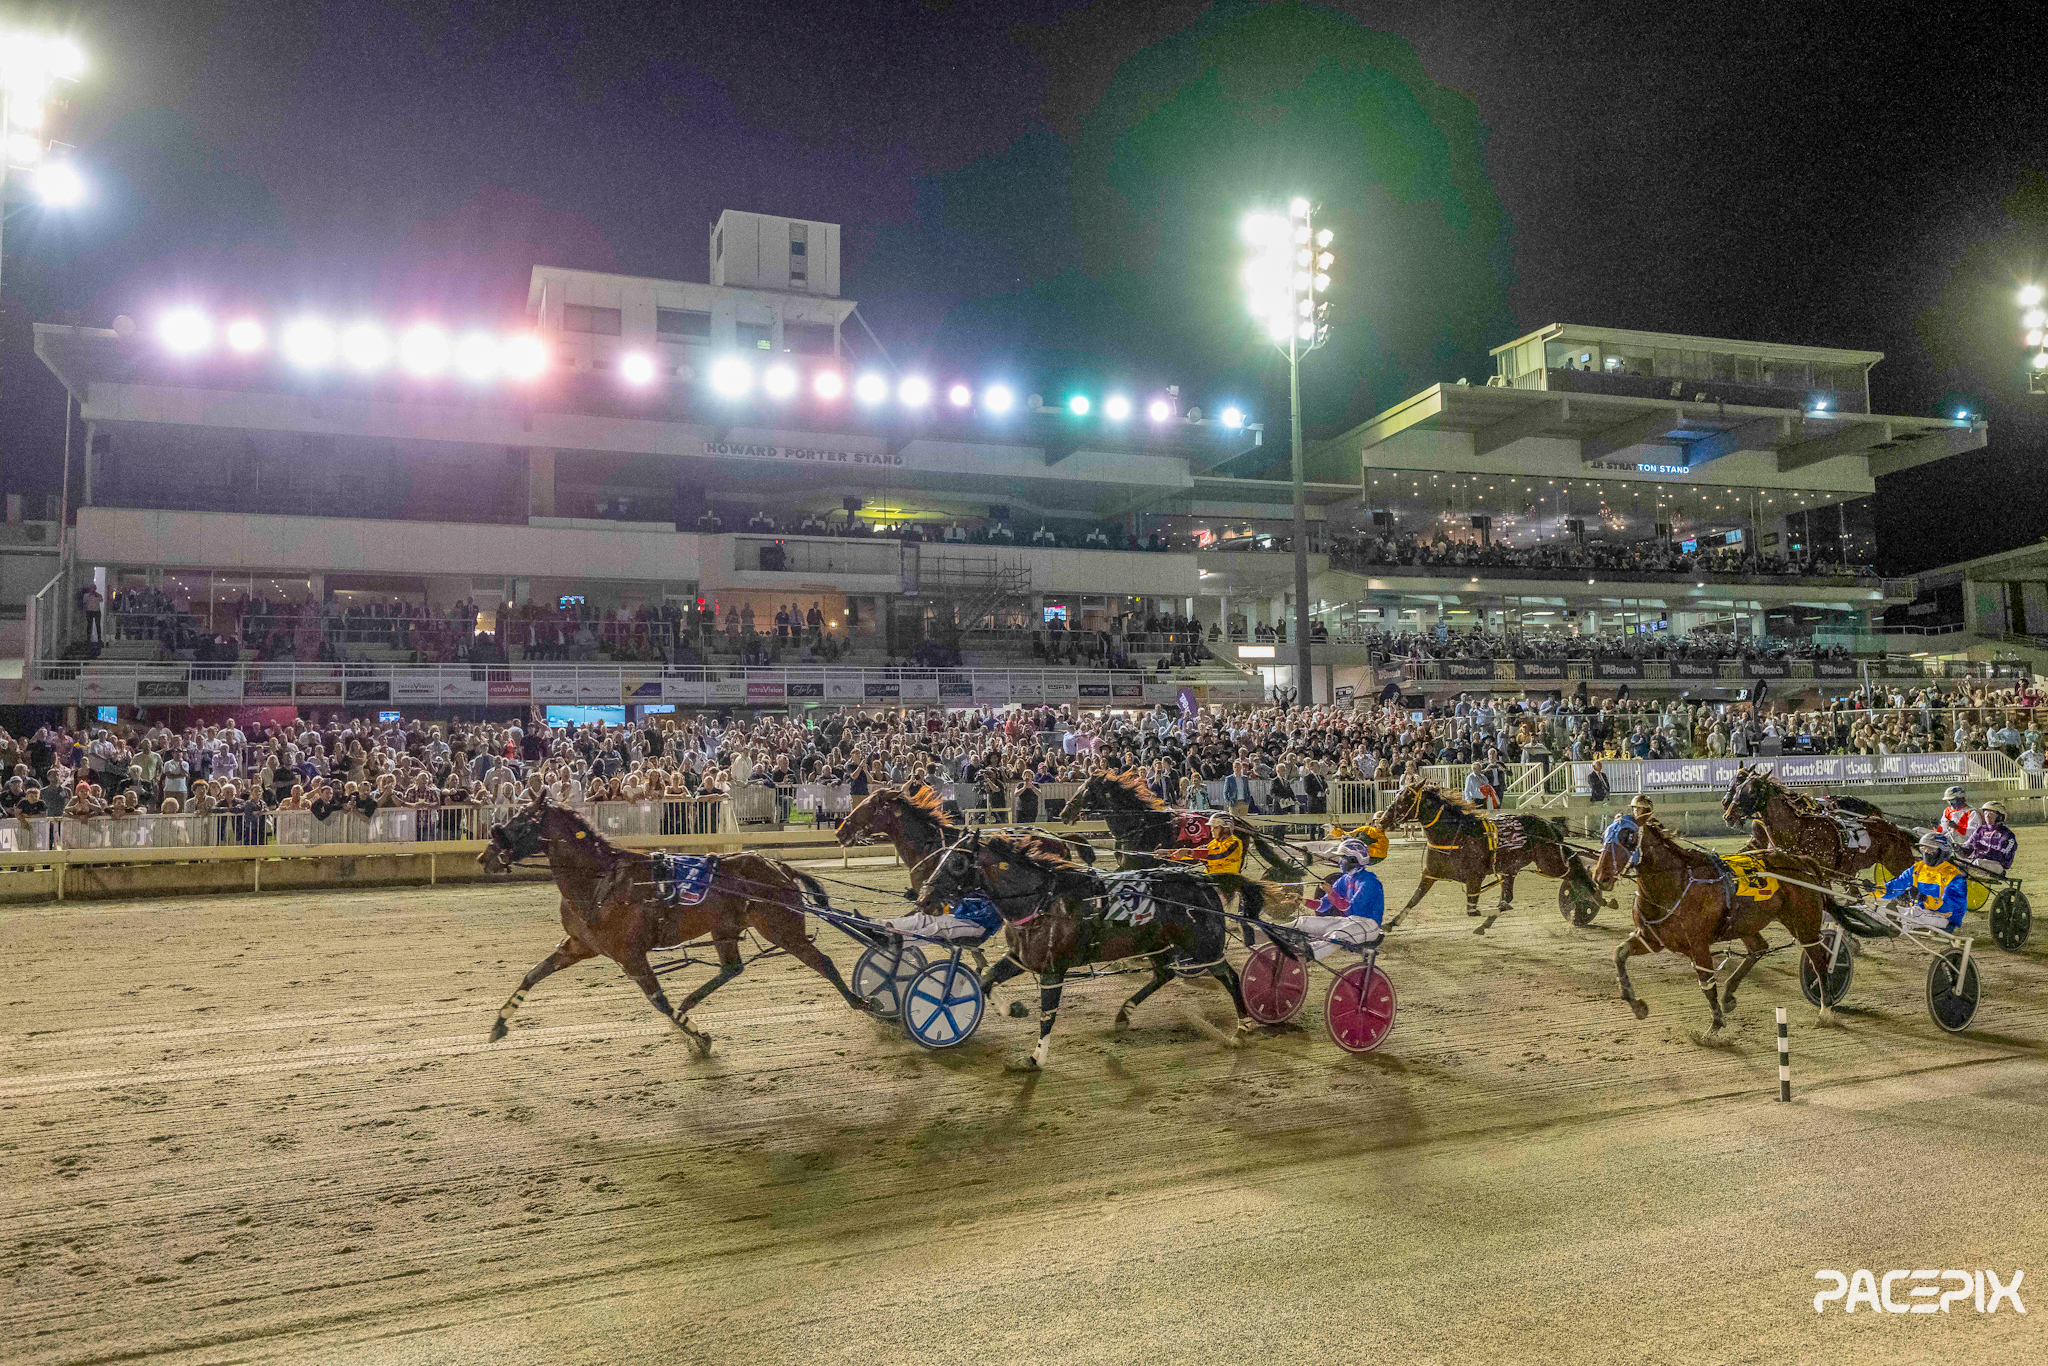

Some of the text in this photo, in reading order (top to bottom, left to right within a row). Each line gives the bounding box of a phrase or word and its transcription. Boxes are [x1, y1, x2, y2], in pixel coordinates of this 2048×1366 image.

[706, 443, 903, 466] HOWARD PORTER STAND
[1606, 462, 1657, 472] STRATTON
[1659, 464, 1690, 474] STAND
[1448, 664, 1487, 675] TABtouch
[1523, 664, 1561, 675] TABtouch
[1600, 664, 1637, 675] TABtouch
[1678, 664, 1713, 675] TABtouch
[1750, 664, 1784, 675] TABtouch
[1819, 664, 1852, 675] TABtouch
[490, 684, 529, 693] retraVision
[748, 685, 783, 694] retraVision
